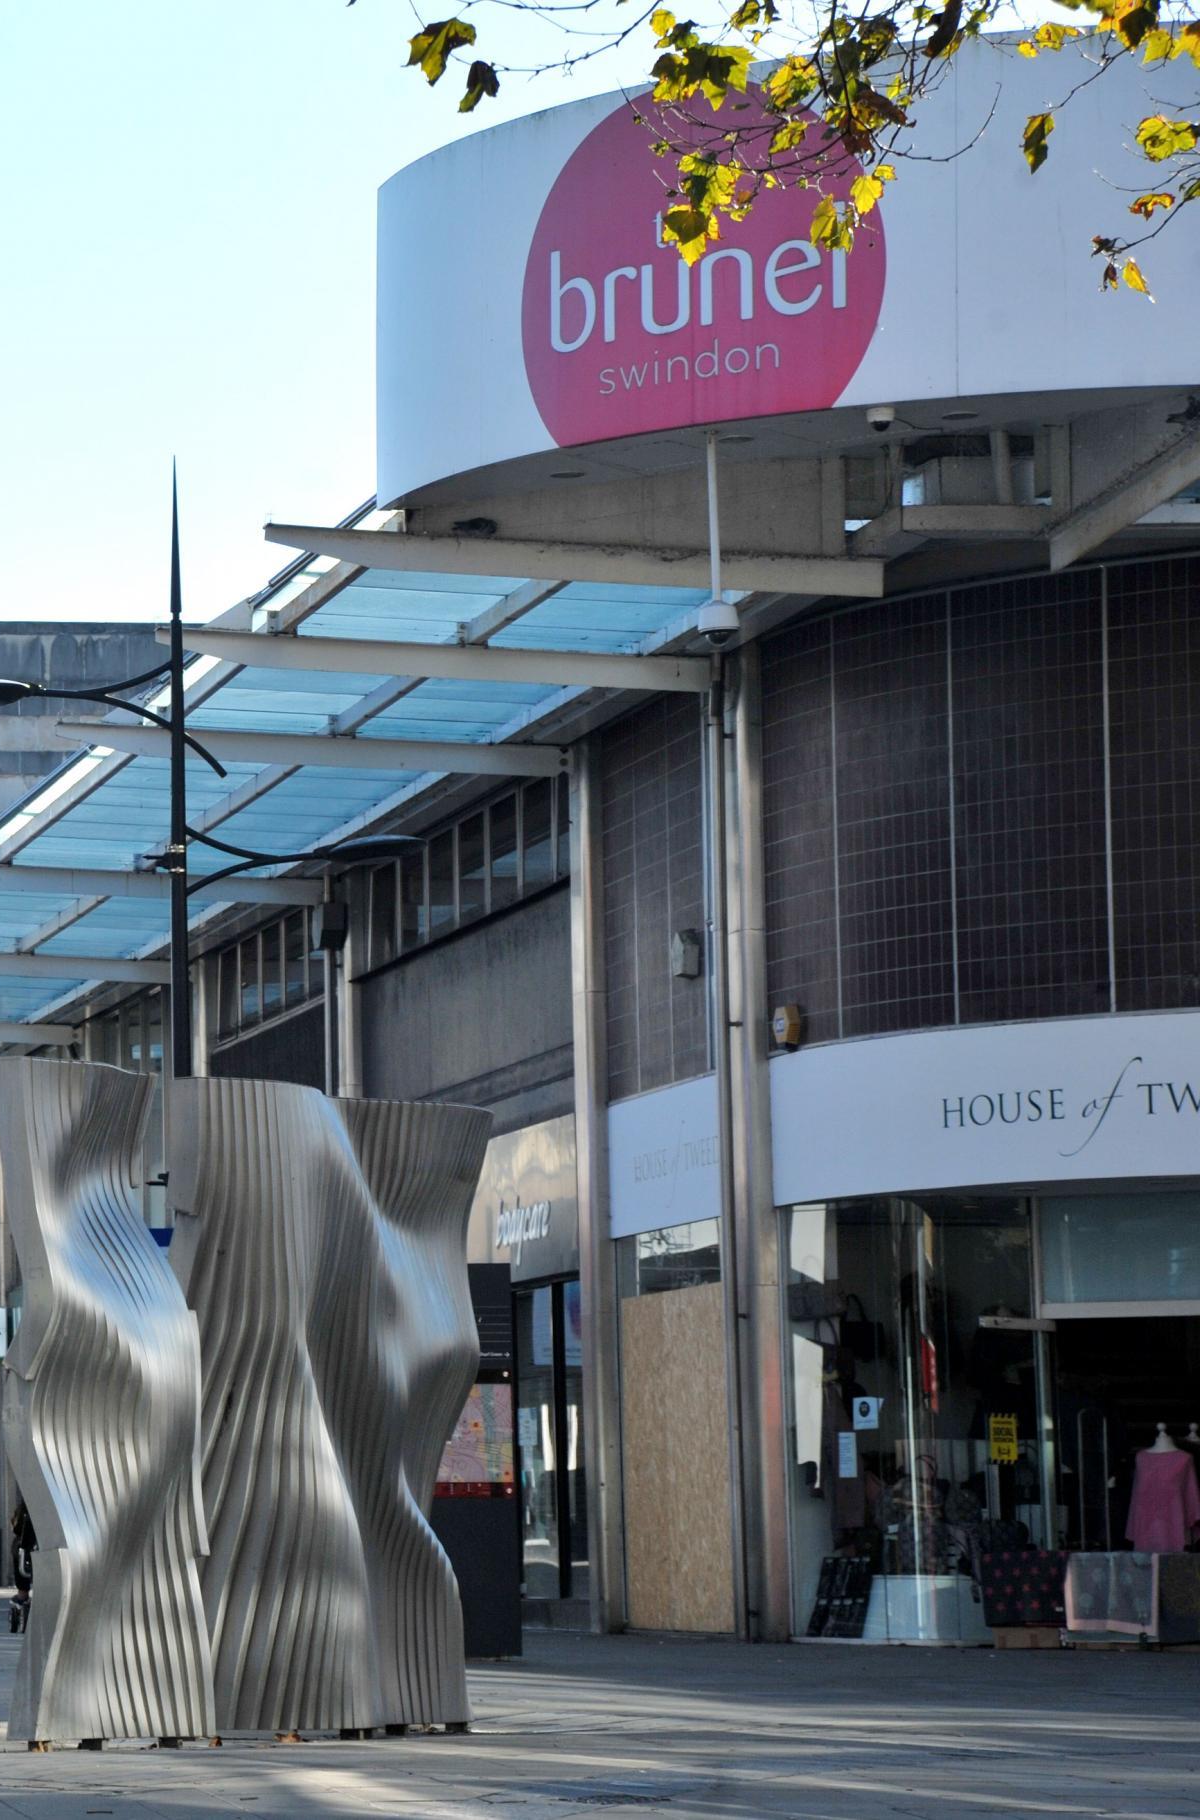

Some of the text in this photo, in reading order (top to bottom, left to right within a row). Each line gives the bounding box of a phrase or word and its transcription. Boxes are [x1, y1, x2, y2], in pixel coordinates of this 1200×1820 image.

[549, 200, 848, 353] brunel
[598, 338, 782, 395] swindon
[942, 1056, 1200, 1157] HOUSE of TW
